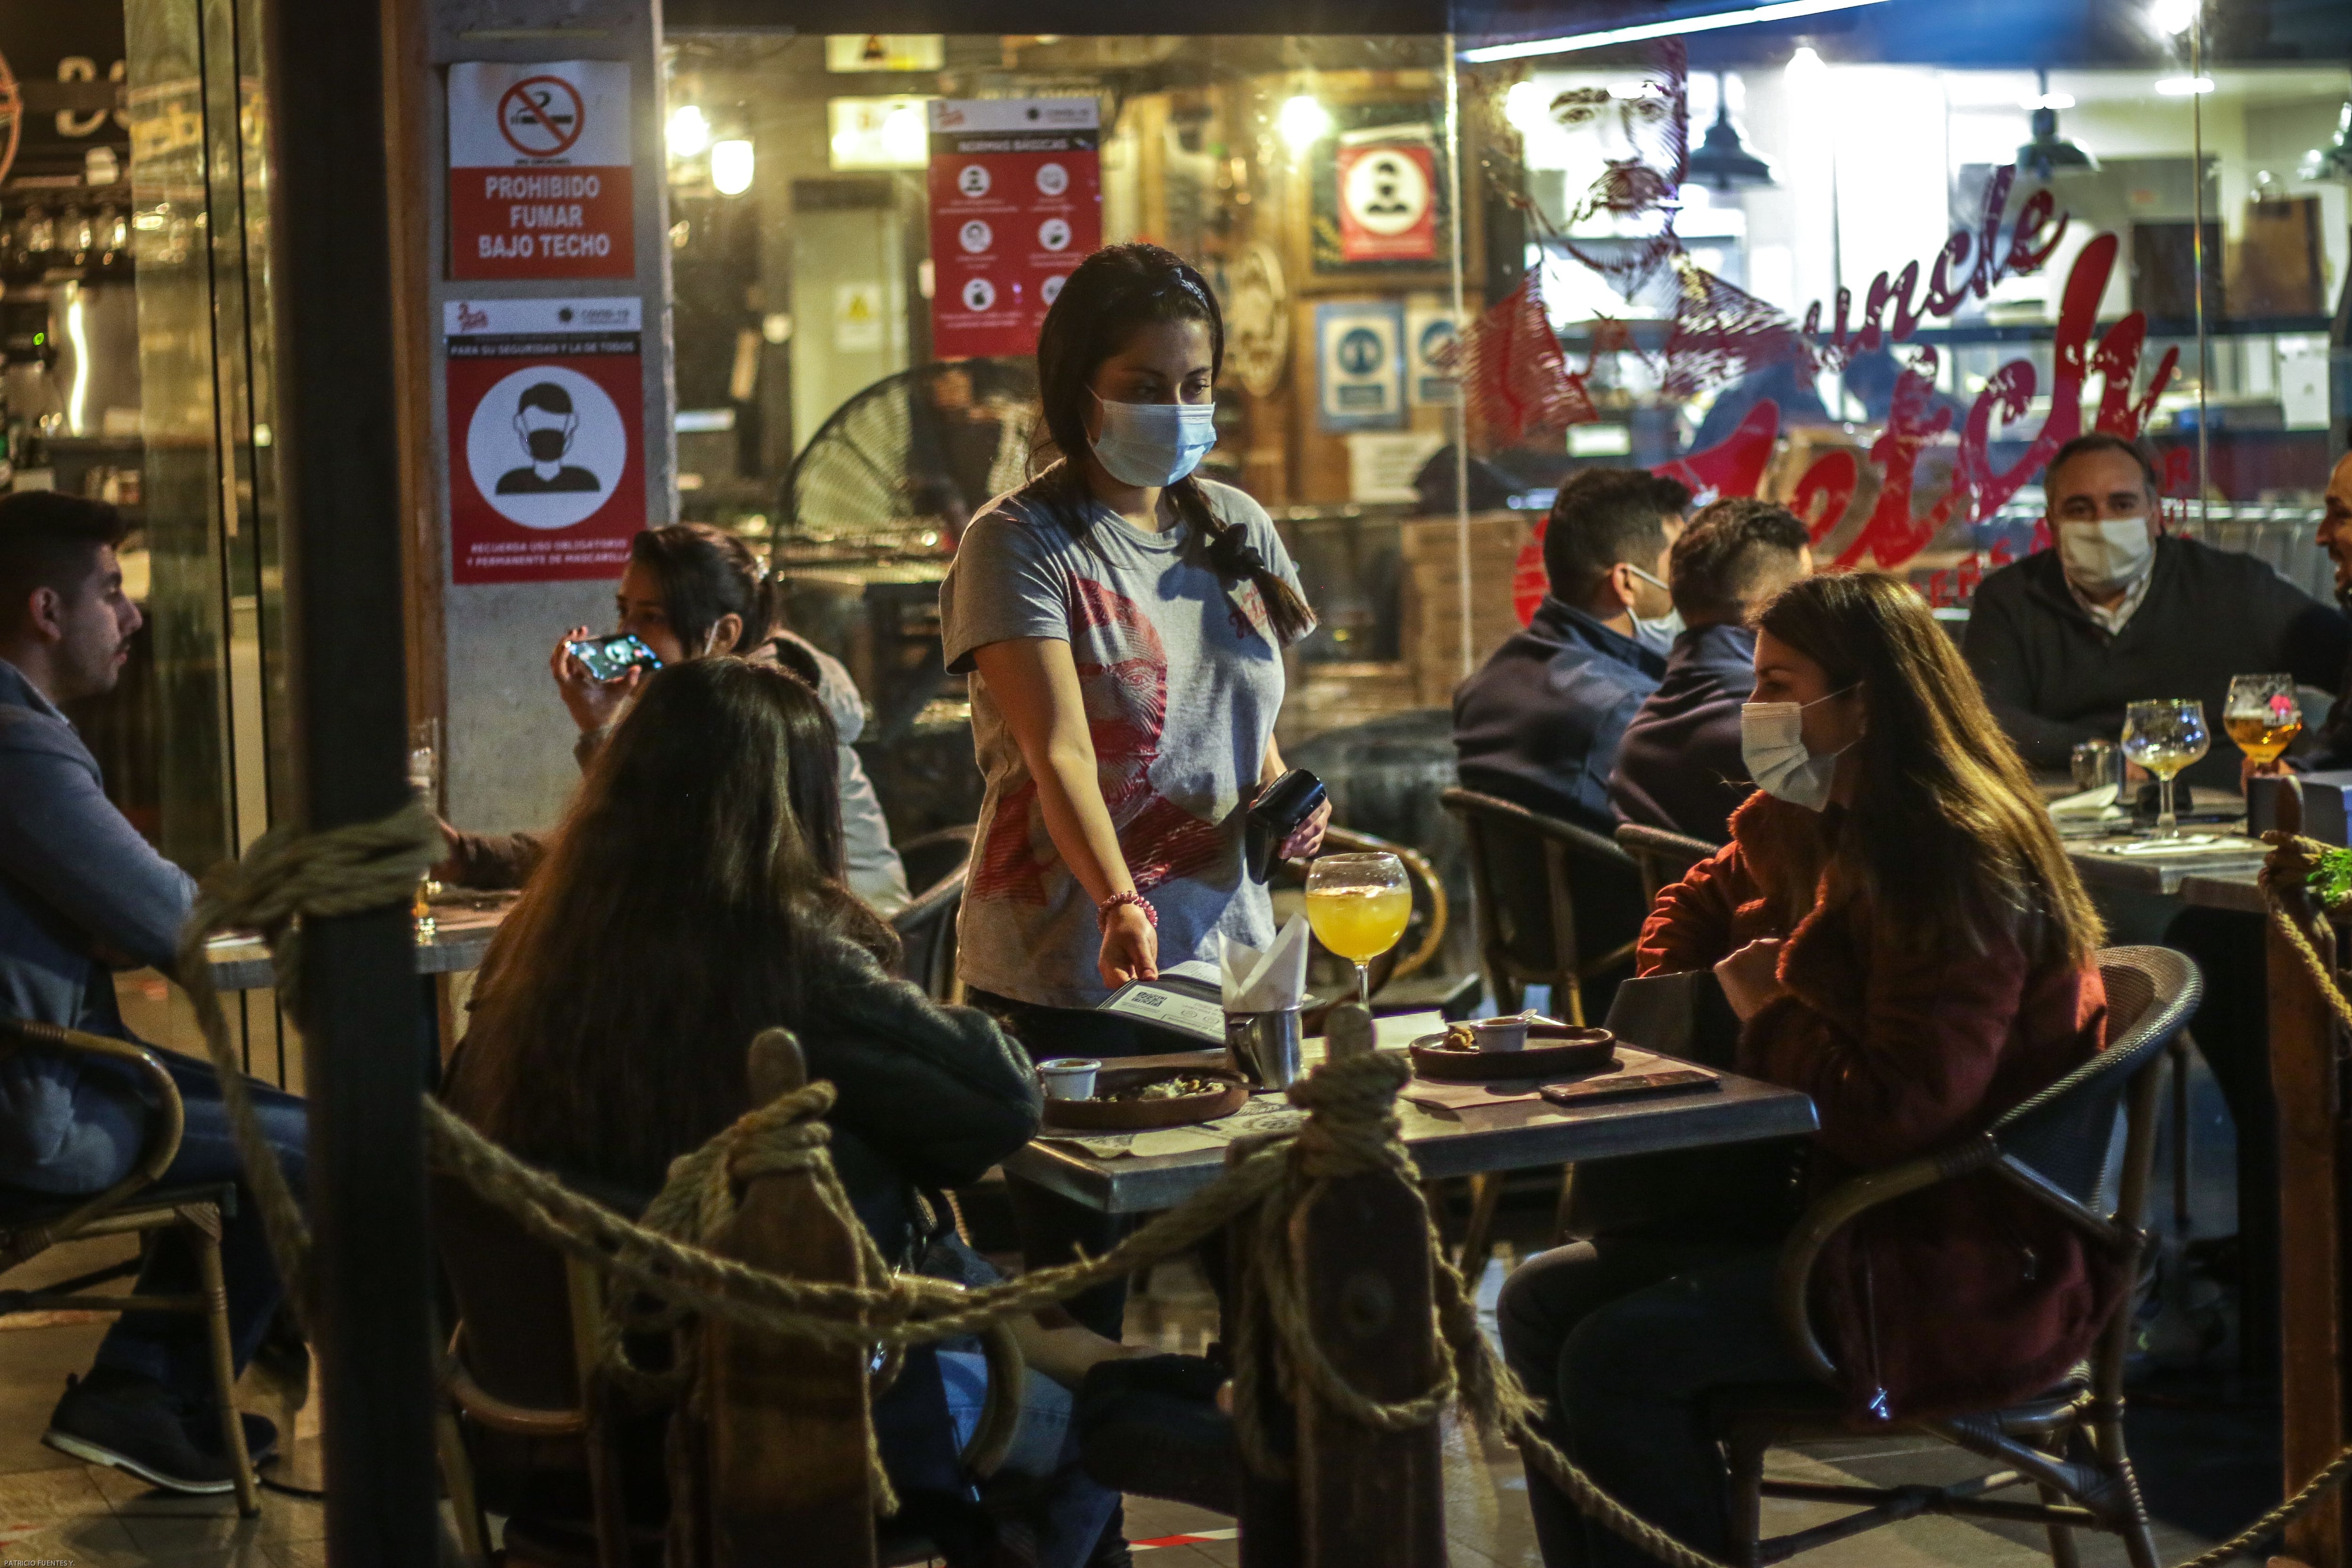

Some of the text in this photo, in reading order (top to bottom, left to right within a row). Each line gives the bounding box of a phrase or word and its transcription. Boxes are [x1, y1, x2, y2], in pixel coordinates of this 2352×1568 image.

[485, 175, 600, 199] PROHIBIDO
[510, 205, 583, 228] FUMAR
[478, 233, 610, 258] BAJO TECHO
[451, 344, 479, 355] PARA
[481, 345, 496, 355] SU
[498, 343, 558, 354] SEGURIDAD
[569, 343, 581, 353] LA
[601, 341, 635, 352] TODOS
